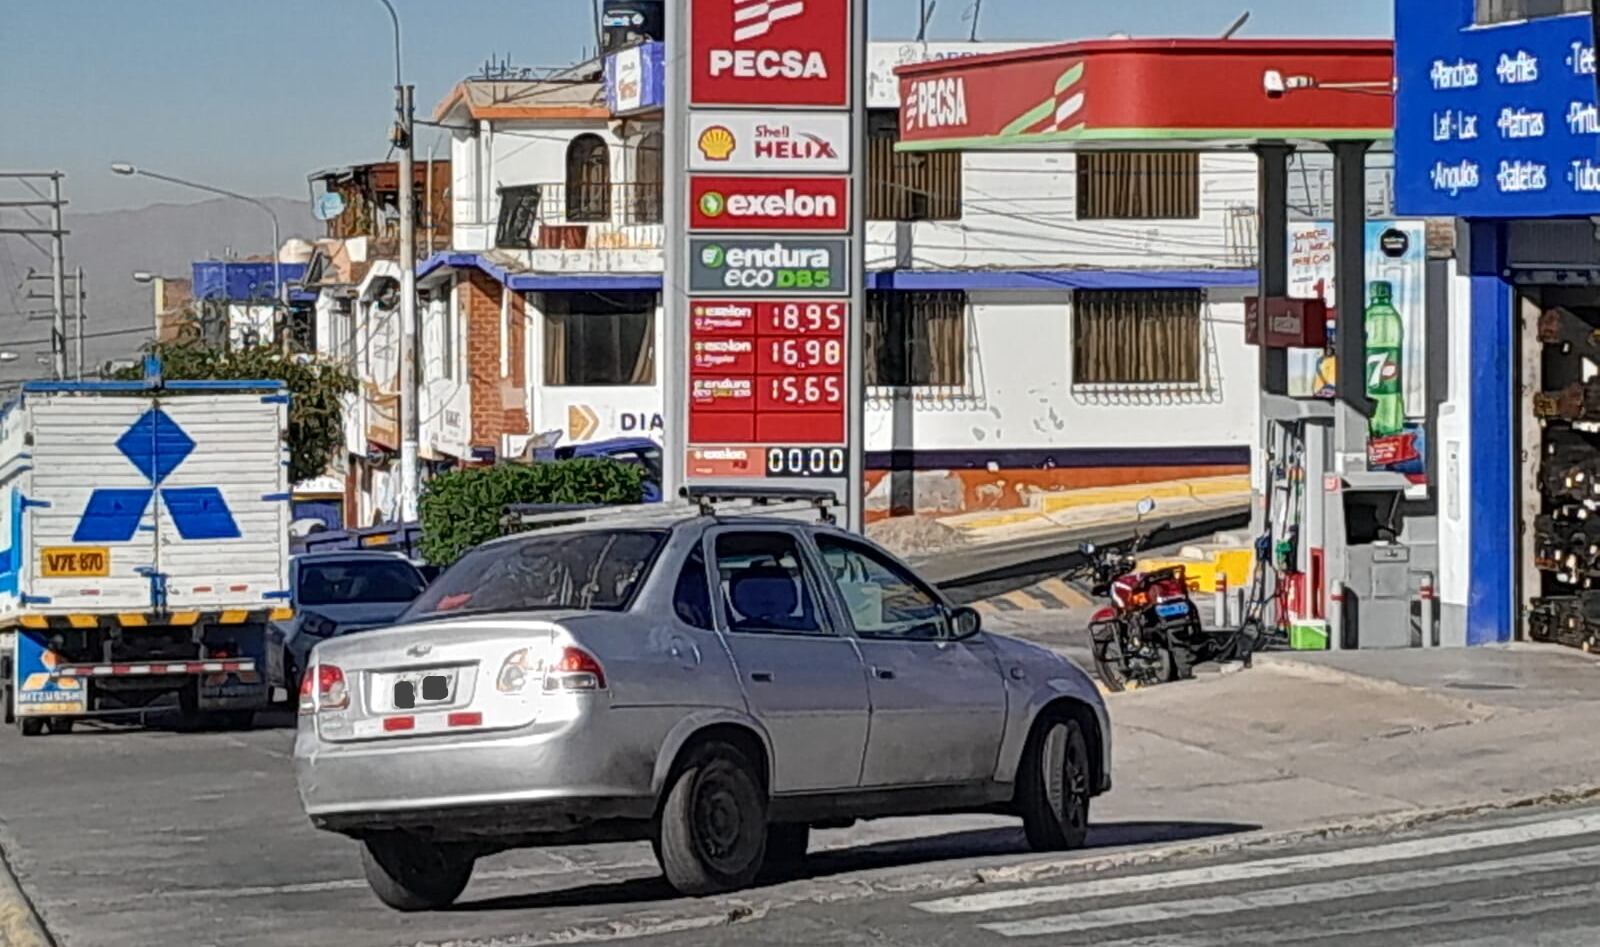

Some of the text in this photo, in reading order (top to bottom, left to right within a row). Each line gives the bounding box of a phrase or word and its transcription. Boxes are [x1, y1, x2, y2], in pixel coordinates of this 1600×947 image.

[709, 49, 827, 78] PECSA
[918, 77, 967, 128] PECSA
[756, 125, 789, 138] Shell
[755, 140, 837, 159] HELIX
[727, 188, 836, 217] exelon
[725, 243, 829, 268] endura
[724, 268, 774, 288] eco
[773, 304, 841, 333] 18.95
[772, 339, 840, 369] 16.98
[772, 376, 839, 404] 15.65
[620, 412, 664, 431] DIA
[768, 448, 844, 476] 00.00
